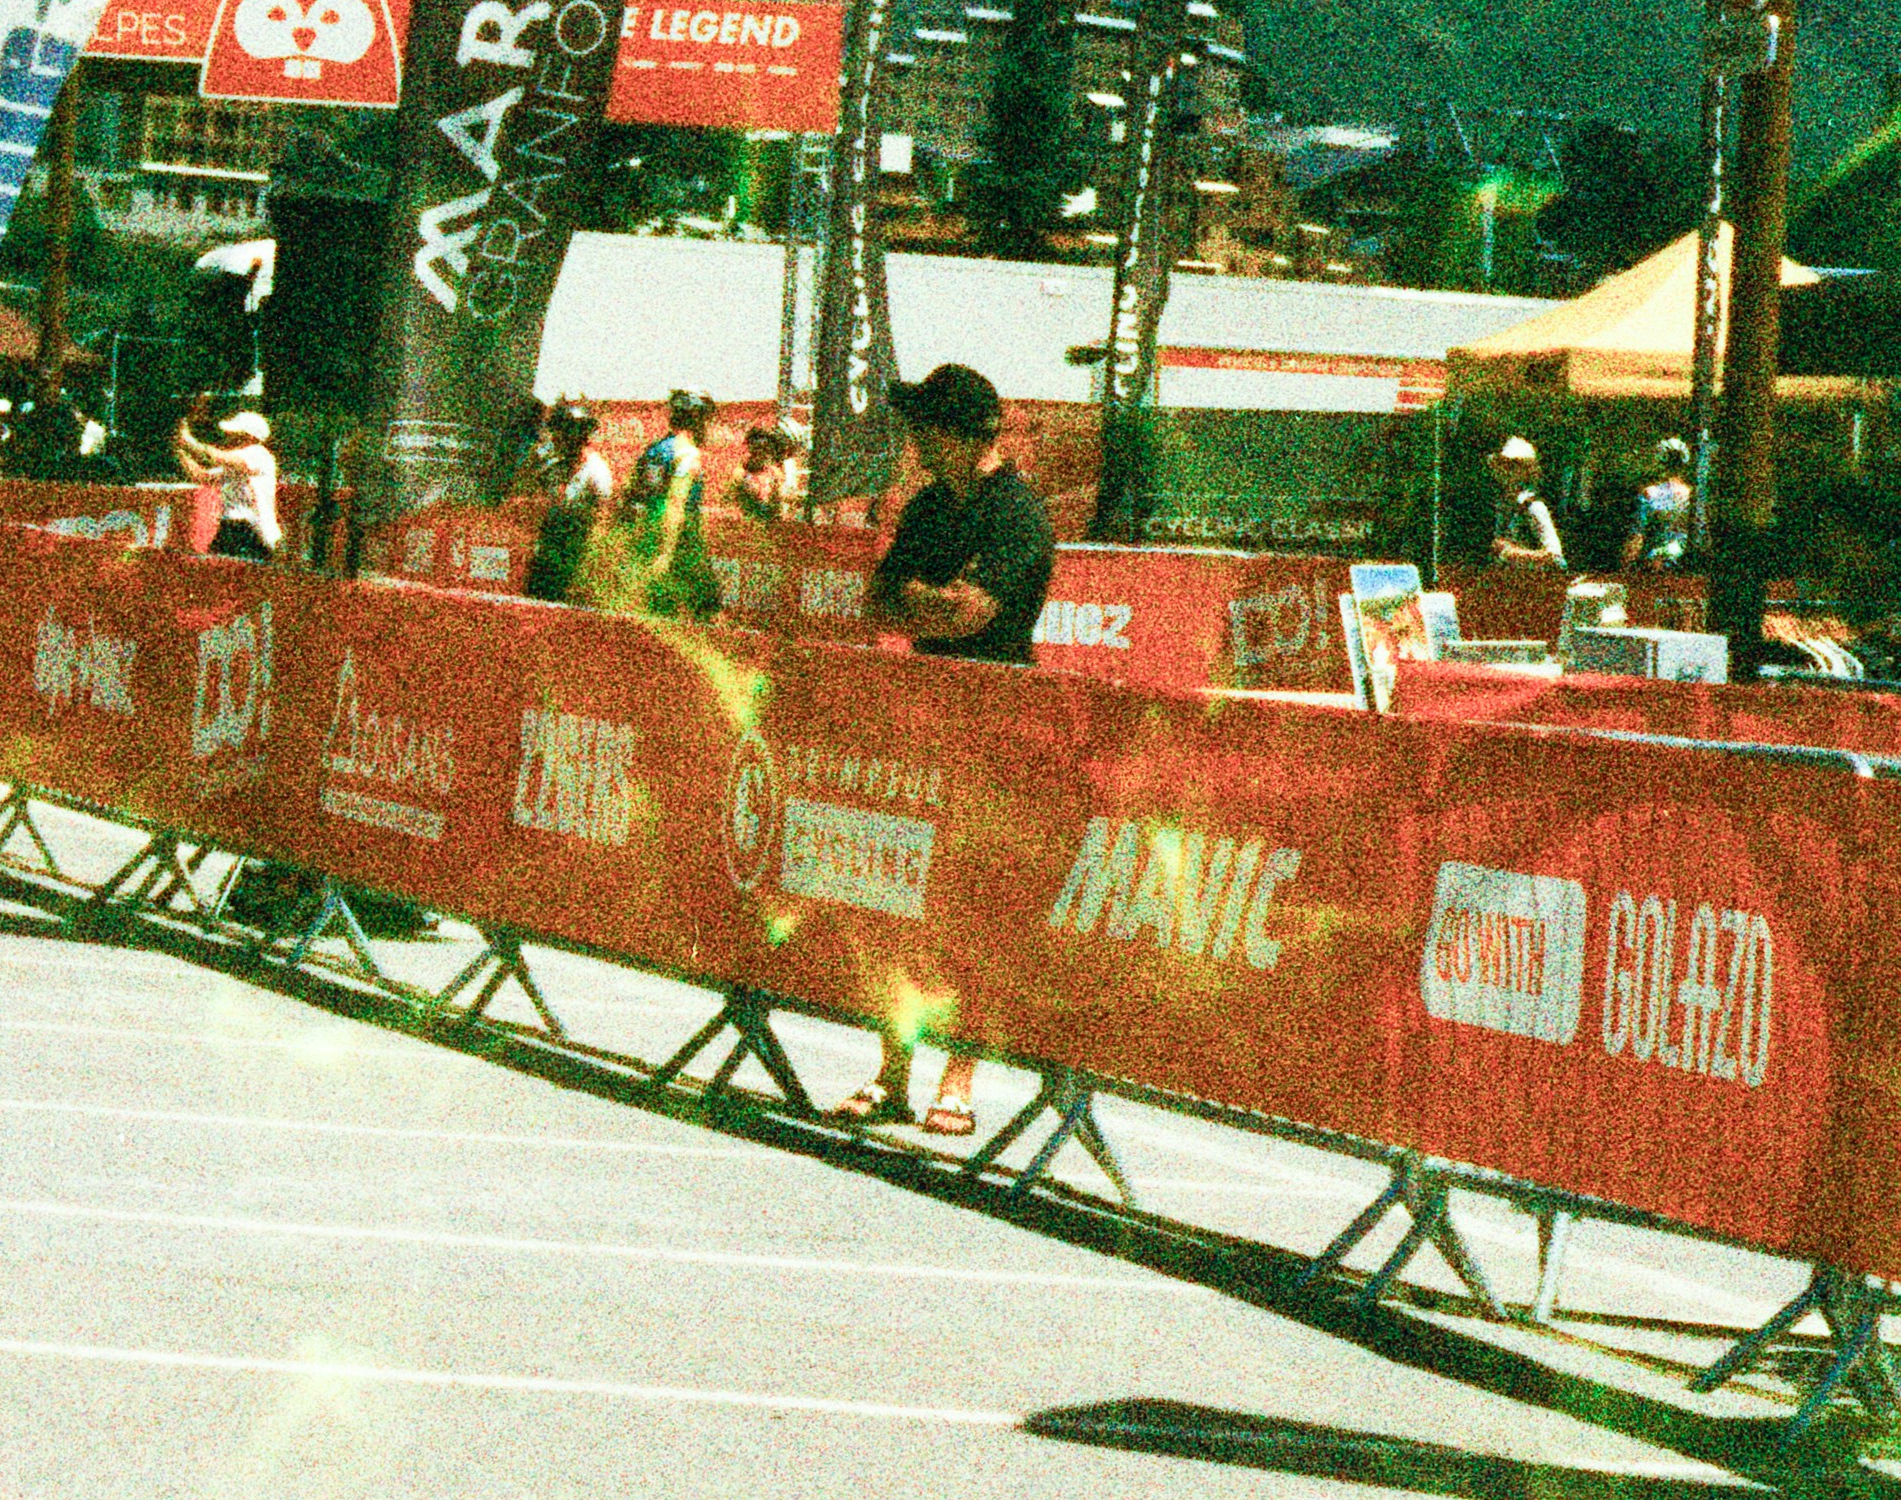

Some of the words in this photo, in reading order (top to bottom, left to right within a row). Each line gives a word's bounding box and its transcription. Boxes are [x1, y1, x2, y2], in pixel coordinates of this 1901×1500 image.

[649, 9, 801, 48] LEGEND
[1048, 814, 1302, 971] MAVIC
[1602, 889, 1774, 1089] GOLAZO
